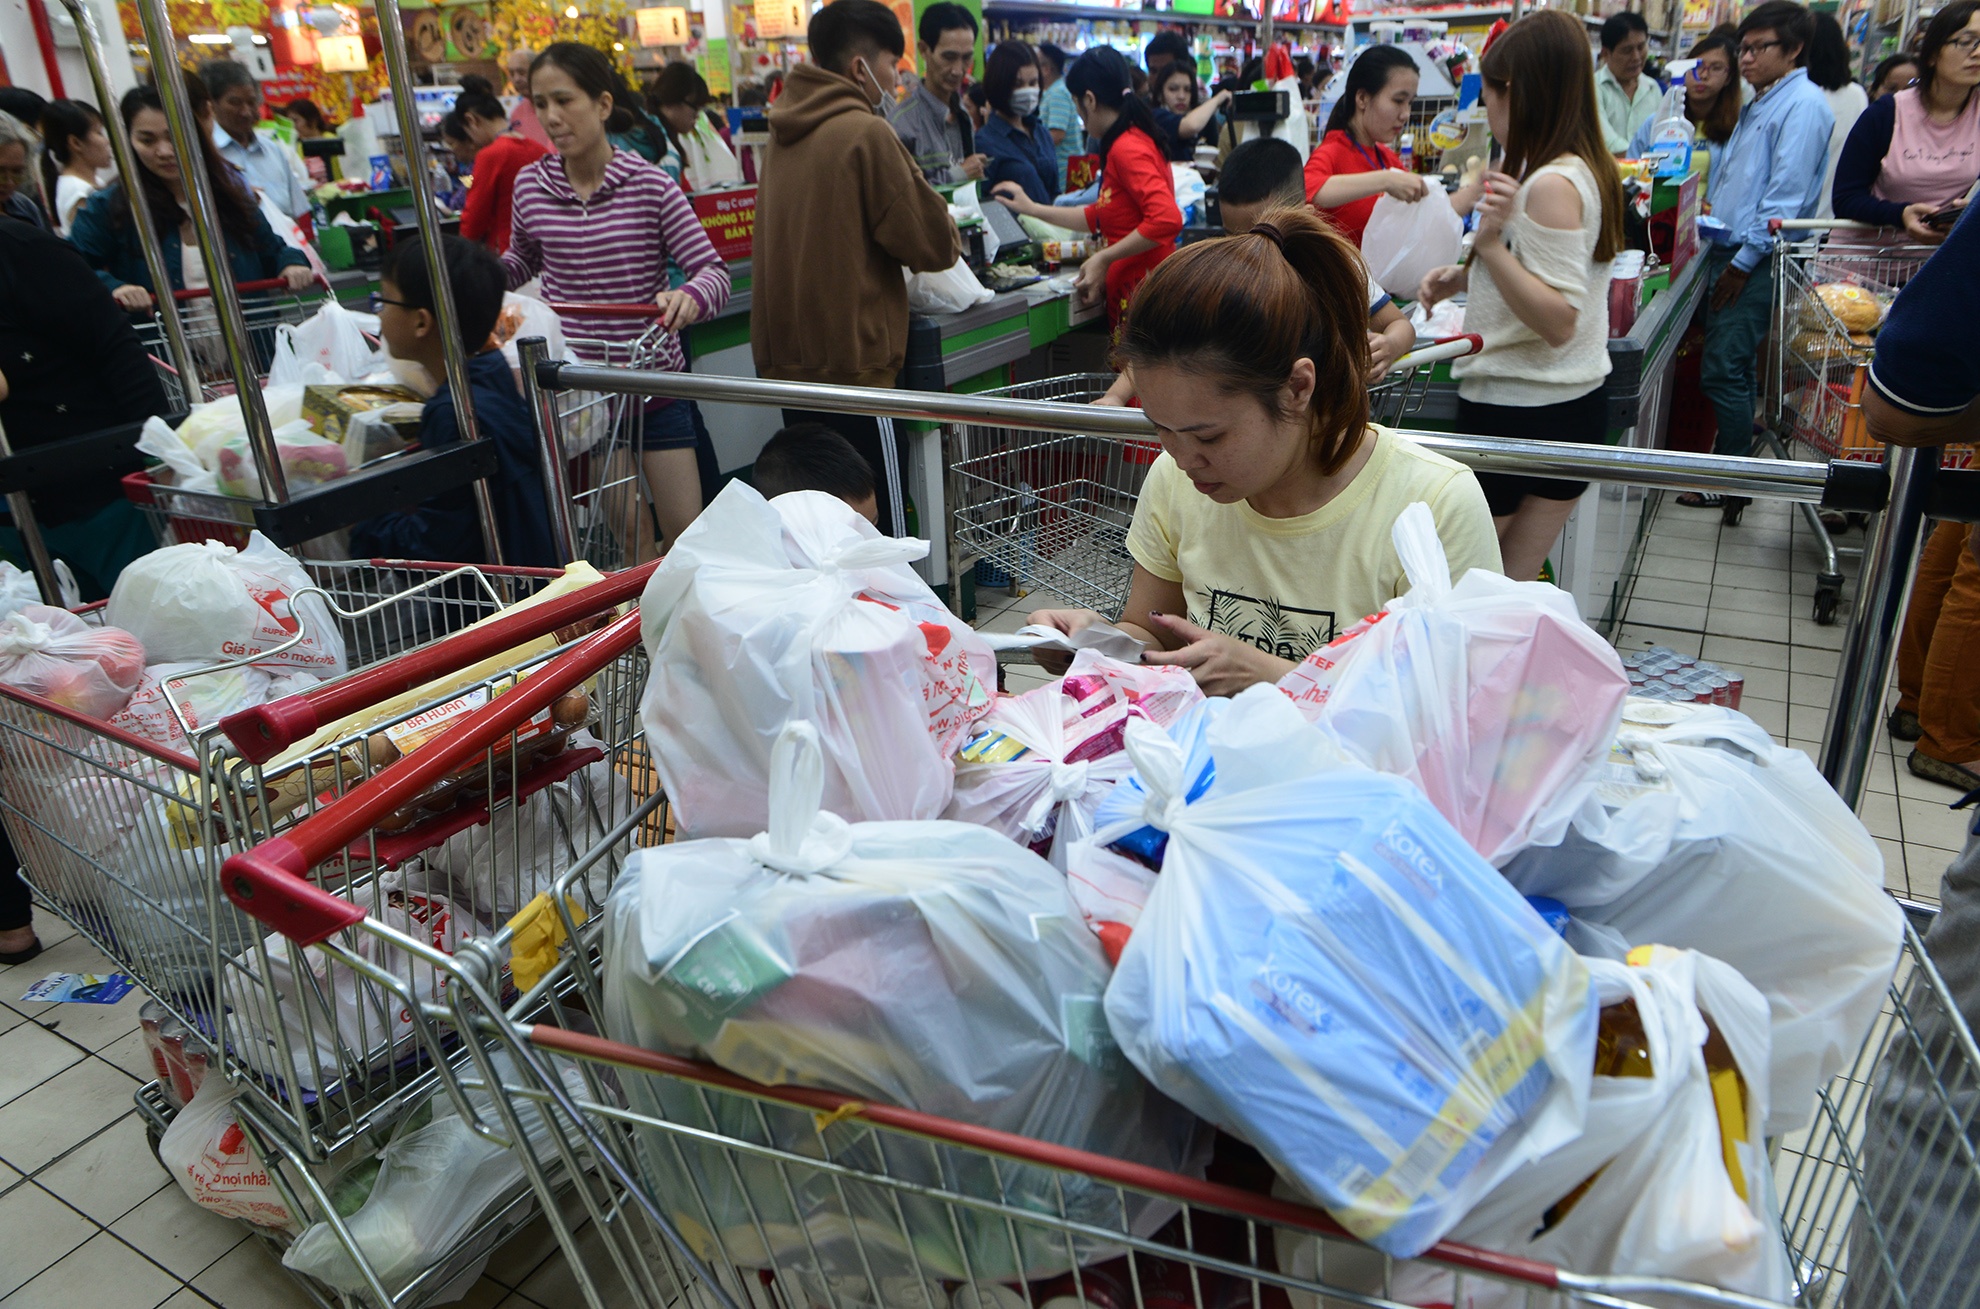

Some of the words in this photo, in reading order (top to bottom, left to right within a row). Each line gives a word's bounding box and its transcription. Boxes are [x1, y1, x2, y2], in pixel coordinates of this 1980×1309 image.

[716, 199, 730, 211] Big
[731, 198, 737, 208] C
[701, 213, 737, 228] KHÔNG
[724, 226, 746, 239] BÁN
[222, 641, 245, 655] Giá
[291, 652, 315, 665] mọi
[405, 717, 427, 729] BA
